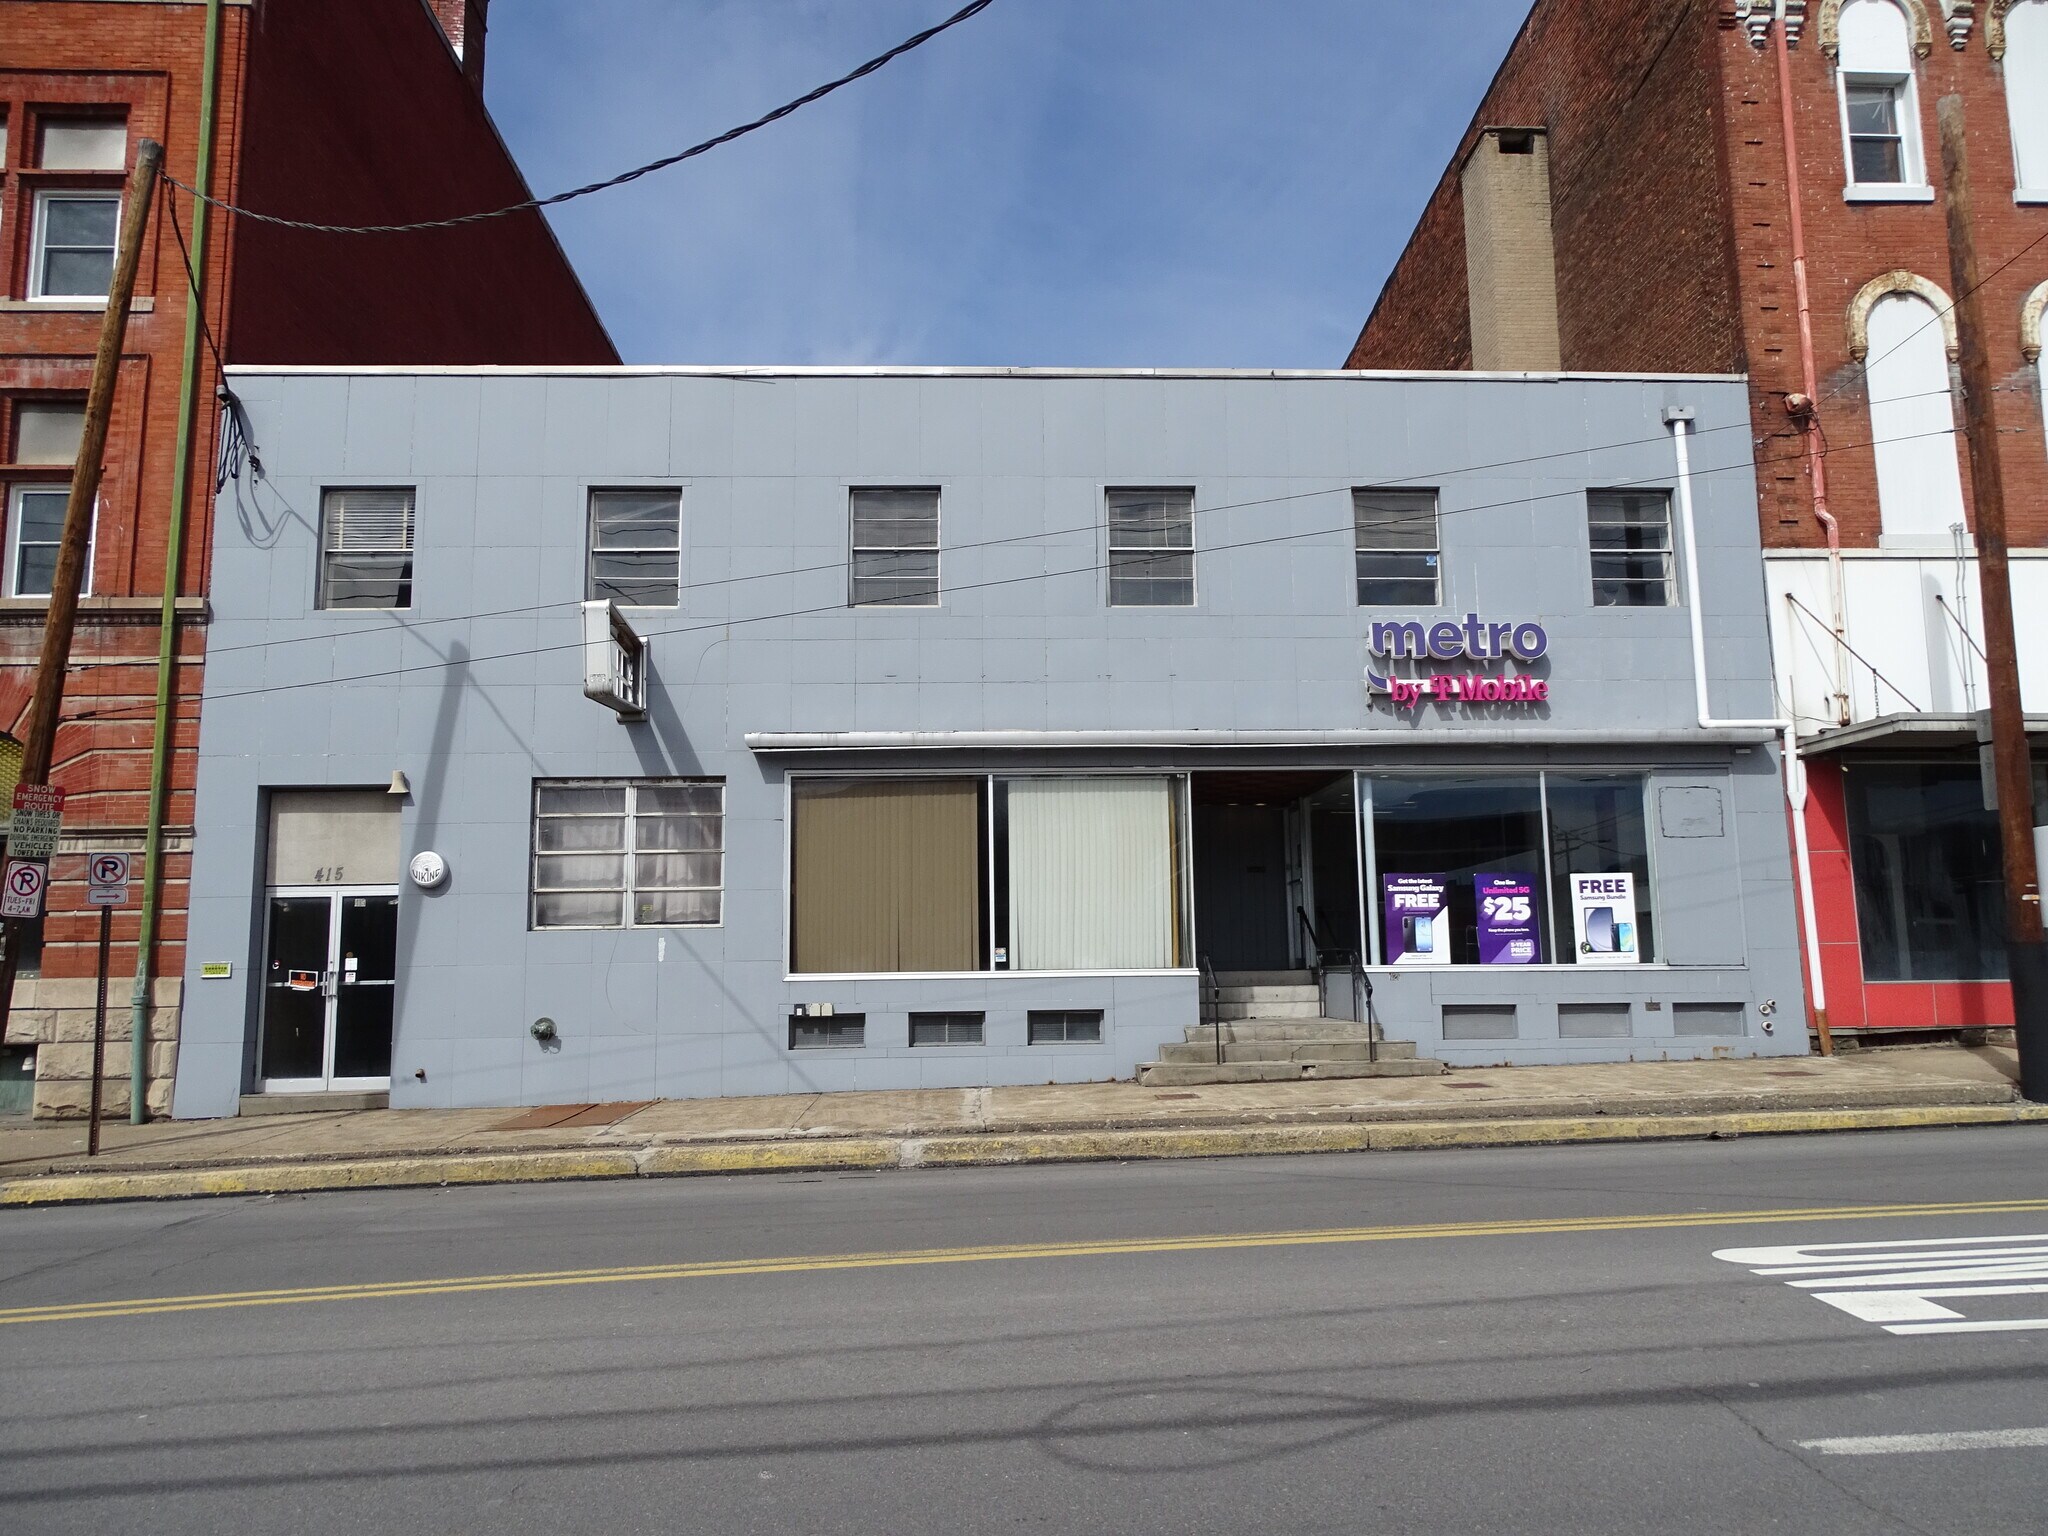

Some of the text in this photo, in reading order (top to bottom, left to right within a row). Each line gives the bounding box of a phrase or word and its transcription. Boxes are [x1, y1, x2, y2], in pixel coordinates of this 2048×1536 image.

[1369, 613, 1548, 660] metro
[1389, 674, 1424, 709] by
[27, 784, 56, 793] SNOW
[16, 792, 63, 802] EMERGENCY
[23, 802, 54, 810] ROUTE
[314, 867, 344, 881] 415
[412, 868, 440, 882] VIKING
[1387, 884, 1444, 892] Samsung Galaxy
[1578, 879, 1626, 893] FREE
[1394, 894, 1440, 908] FREE
[1483, 896, 1531, 920] $25
